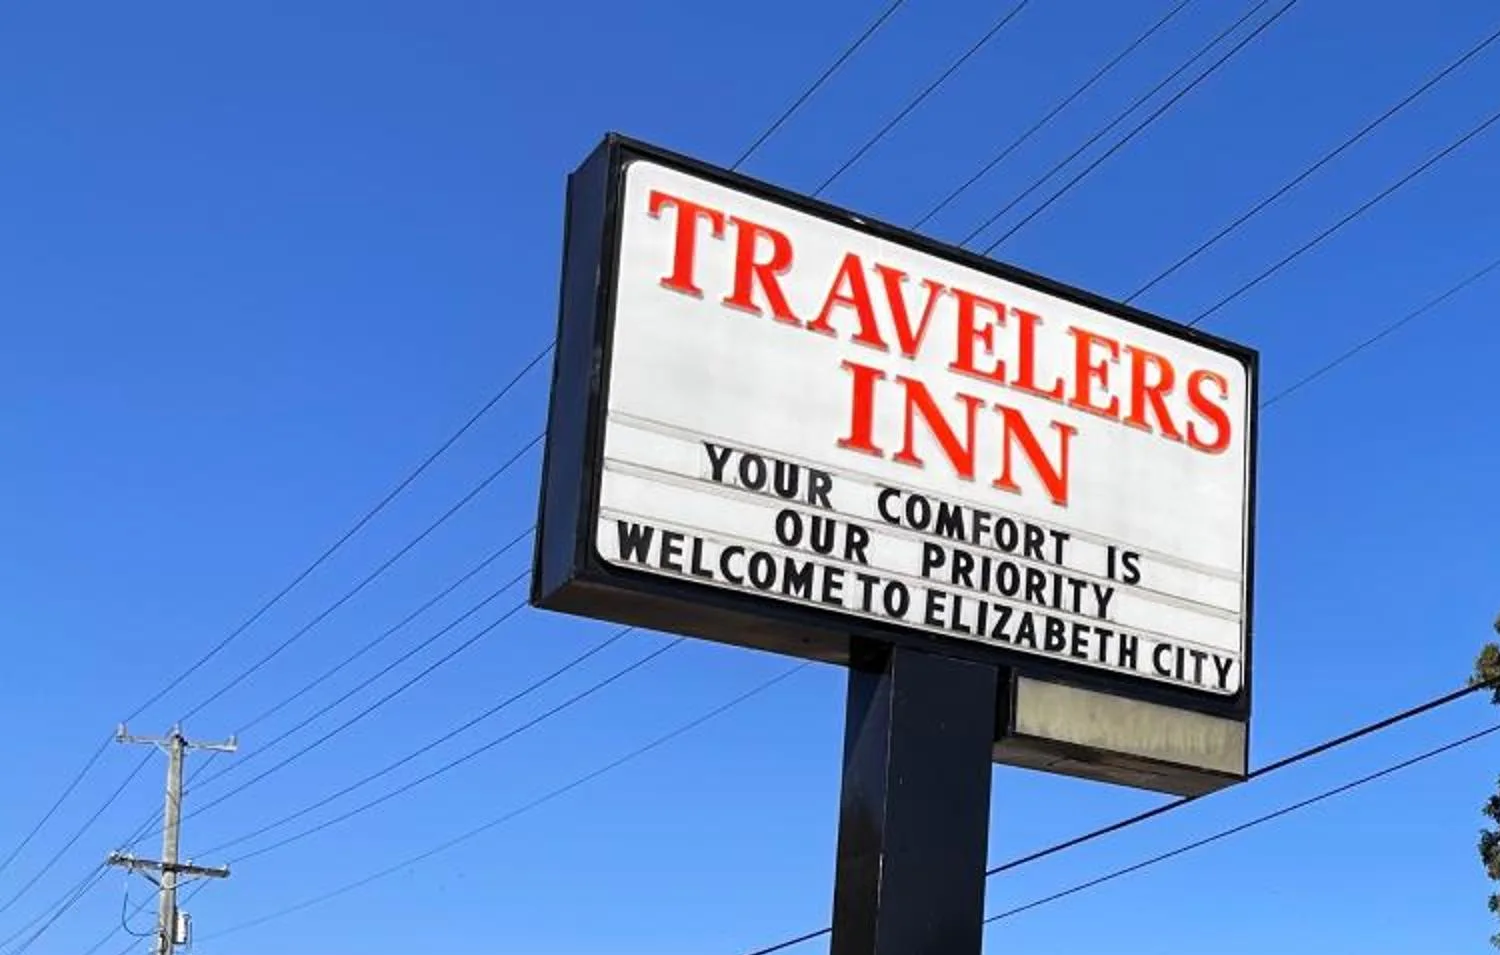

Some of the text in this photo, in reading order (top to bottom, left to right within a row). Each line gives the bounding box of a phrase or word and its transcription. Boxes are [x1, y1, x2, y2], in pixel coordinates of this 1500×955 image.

[648, 190, 1232, 455] TRAVELERS
[837, 359, 1078, 507] INN
[703, 441, 1141, 586] YOUR COMFORT IS
[775, 508, 1115, 620] OUR PRIORITY
[616, 519, 1233, 690] WELCOME TO ELIZABETH CITY
